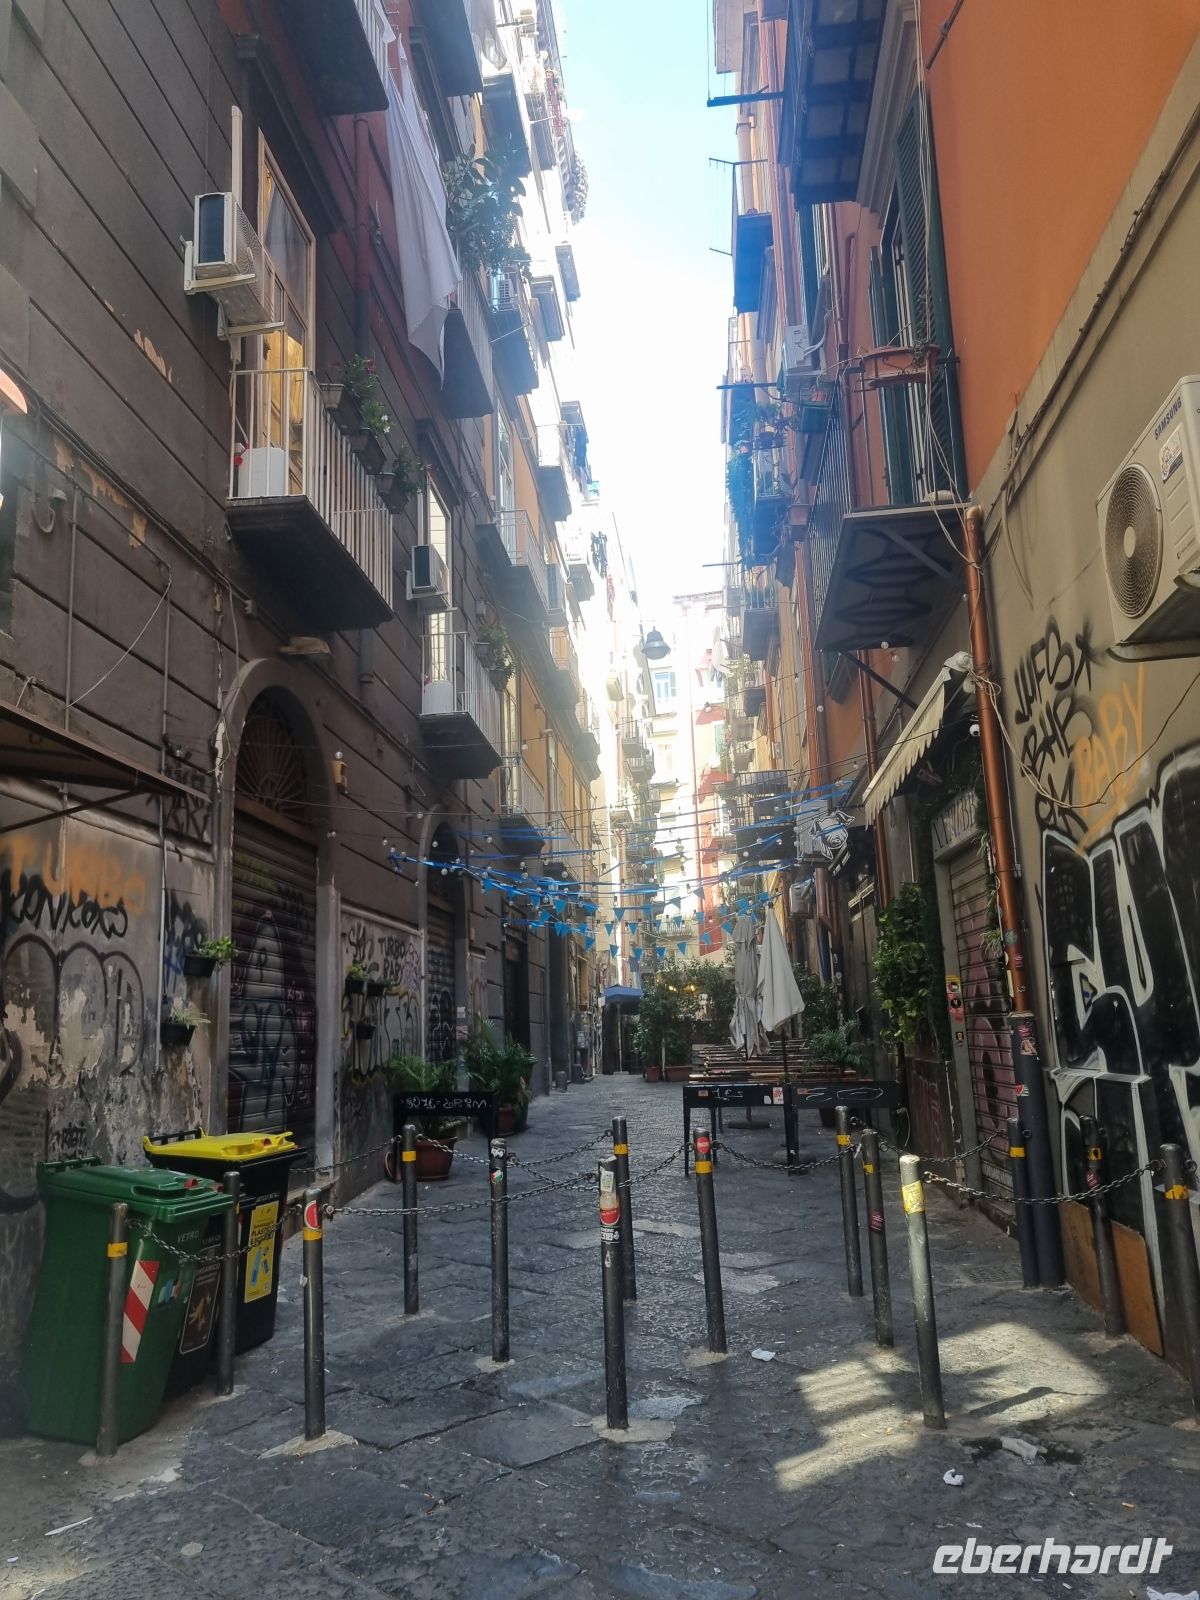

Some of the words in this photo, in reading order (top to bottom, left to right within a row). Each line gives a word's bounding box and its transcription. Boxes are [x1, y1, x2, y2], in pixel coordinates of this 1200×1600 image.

[1154, 396, 1182, 441] SAMSUNG
[0, 833, 146, 917] TURBO
[378, 936, 406, 961] TURBO
[178, 1230, 200, 1244] VETRO
